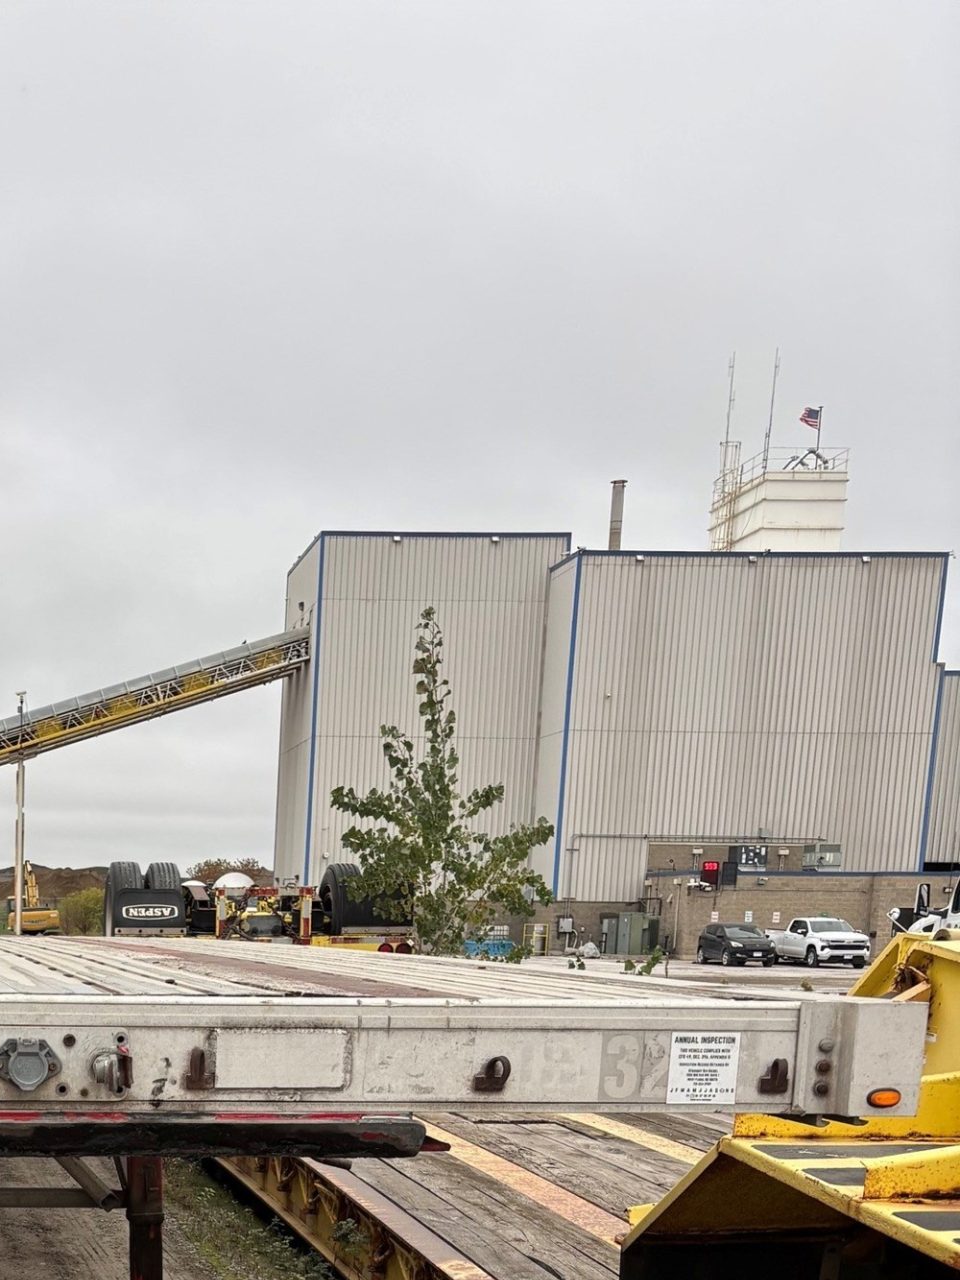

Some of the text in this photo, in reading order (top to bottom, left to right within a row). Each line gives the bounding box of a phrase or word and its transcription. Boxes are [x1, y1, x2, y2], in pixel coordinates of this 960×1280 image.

[128, 907, 172, 917] ASPEN
[674, 1035, 737, 1045] ANNUAL INSPECTION
